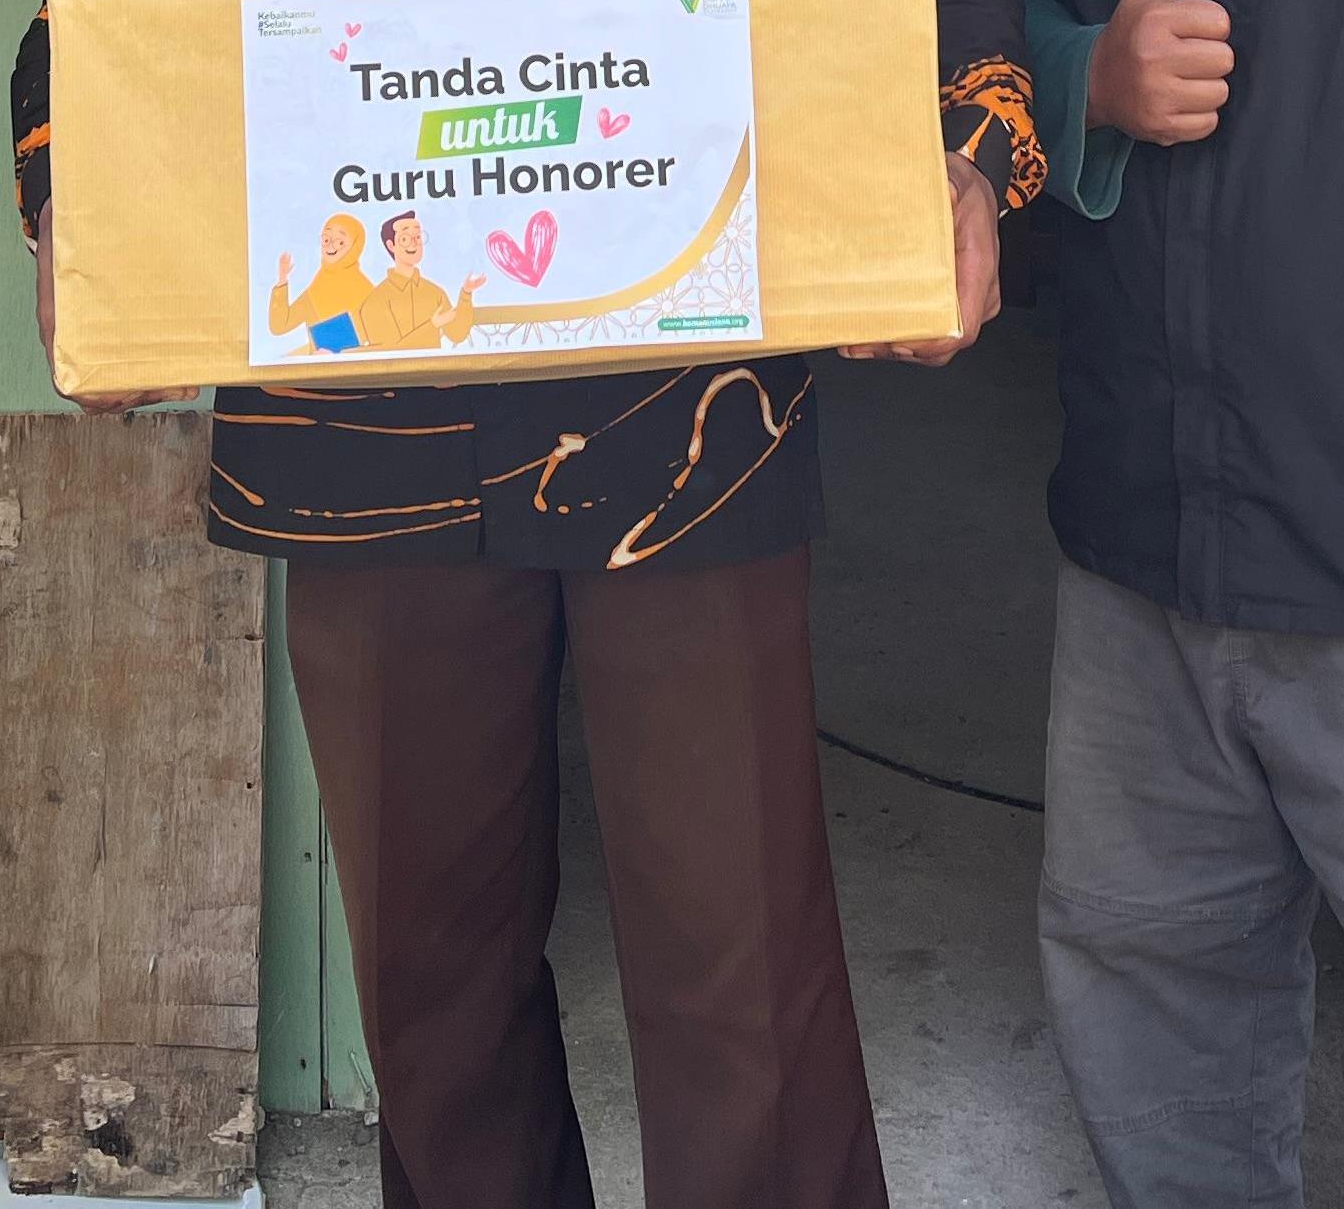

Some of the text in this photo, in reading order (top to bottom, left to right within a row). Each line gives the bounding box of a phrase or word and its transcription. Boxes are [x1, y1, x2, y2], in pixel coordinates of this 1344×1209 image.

[350, 51, 650, 101] Tanda Cinta
[439, 107, 560, 151] untuk
[333, 156, 675, 203] Guru Honorer
